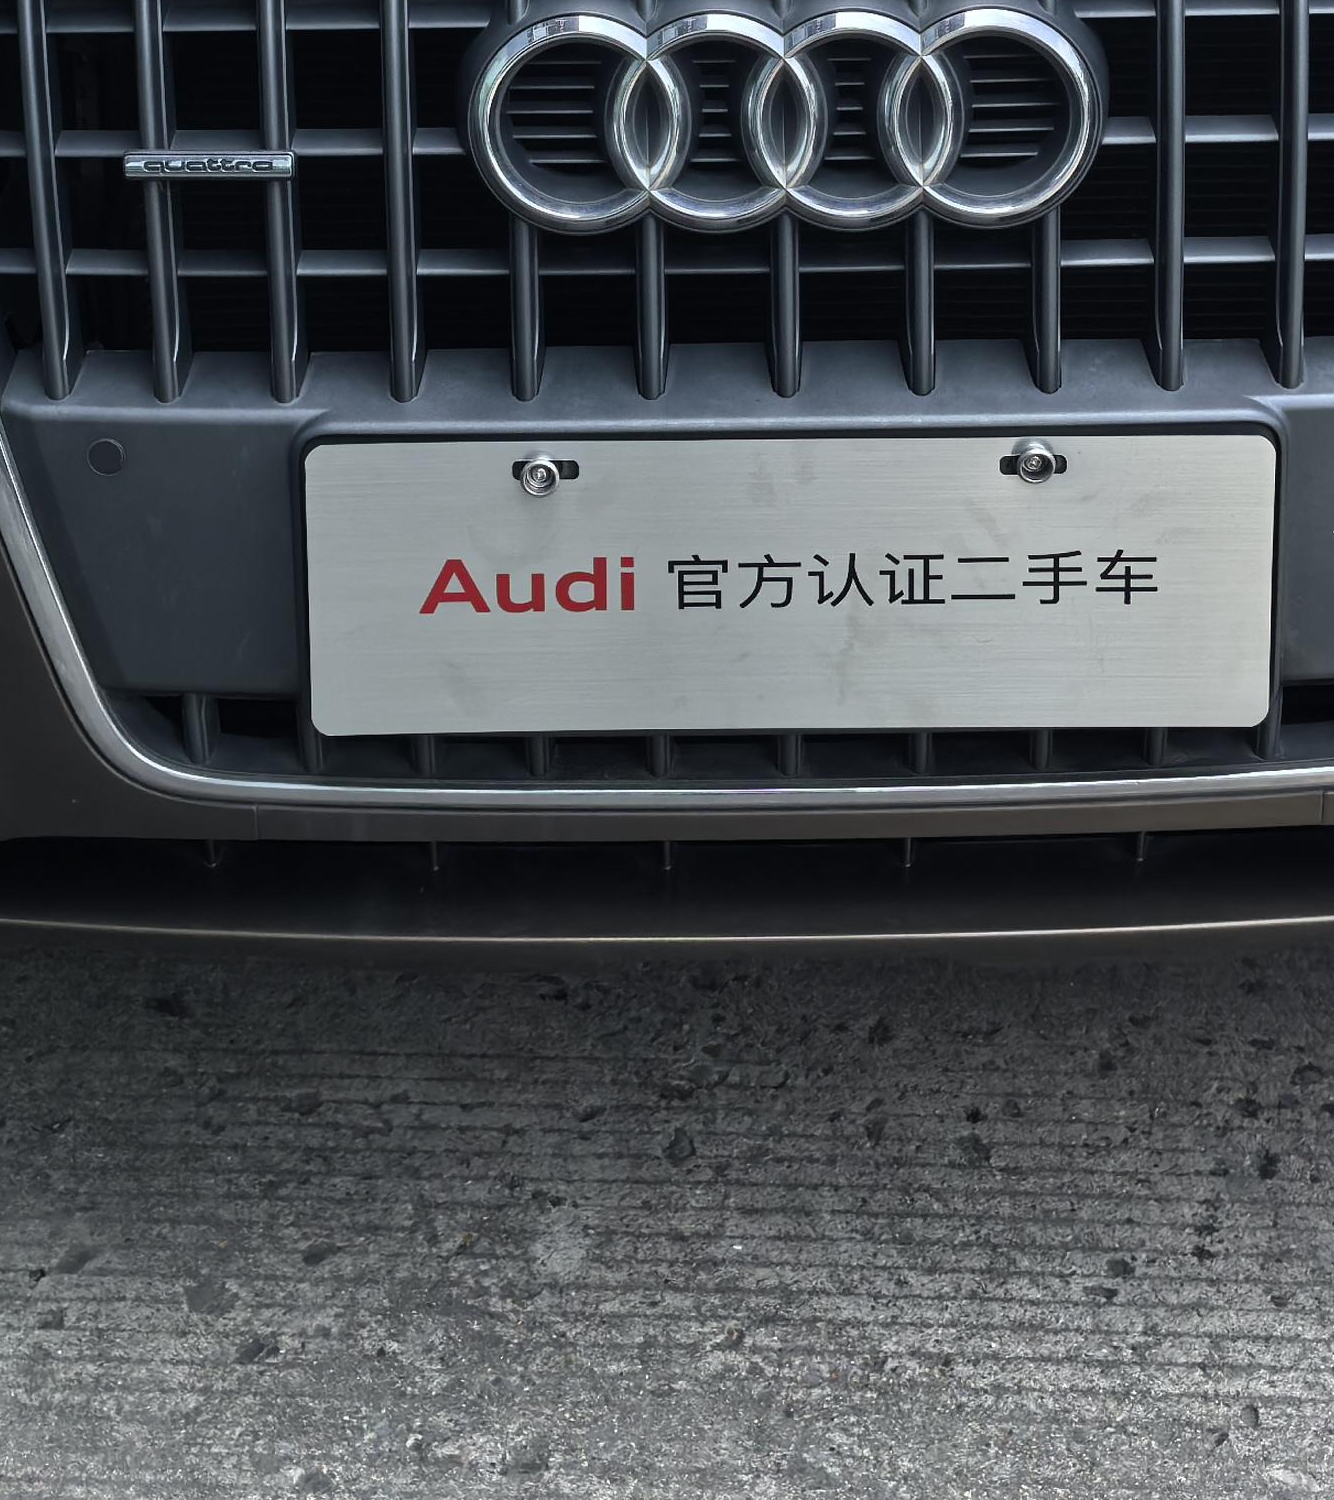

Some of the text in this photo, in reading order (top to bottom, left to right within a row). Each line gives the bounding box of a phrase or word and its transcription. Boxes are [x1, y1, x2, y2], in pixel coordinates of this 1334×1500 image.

[143, 159, 273, 174] quattro
[419, 548, 1159, 614] Audi 官方认证二手车
